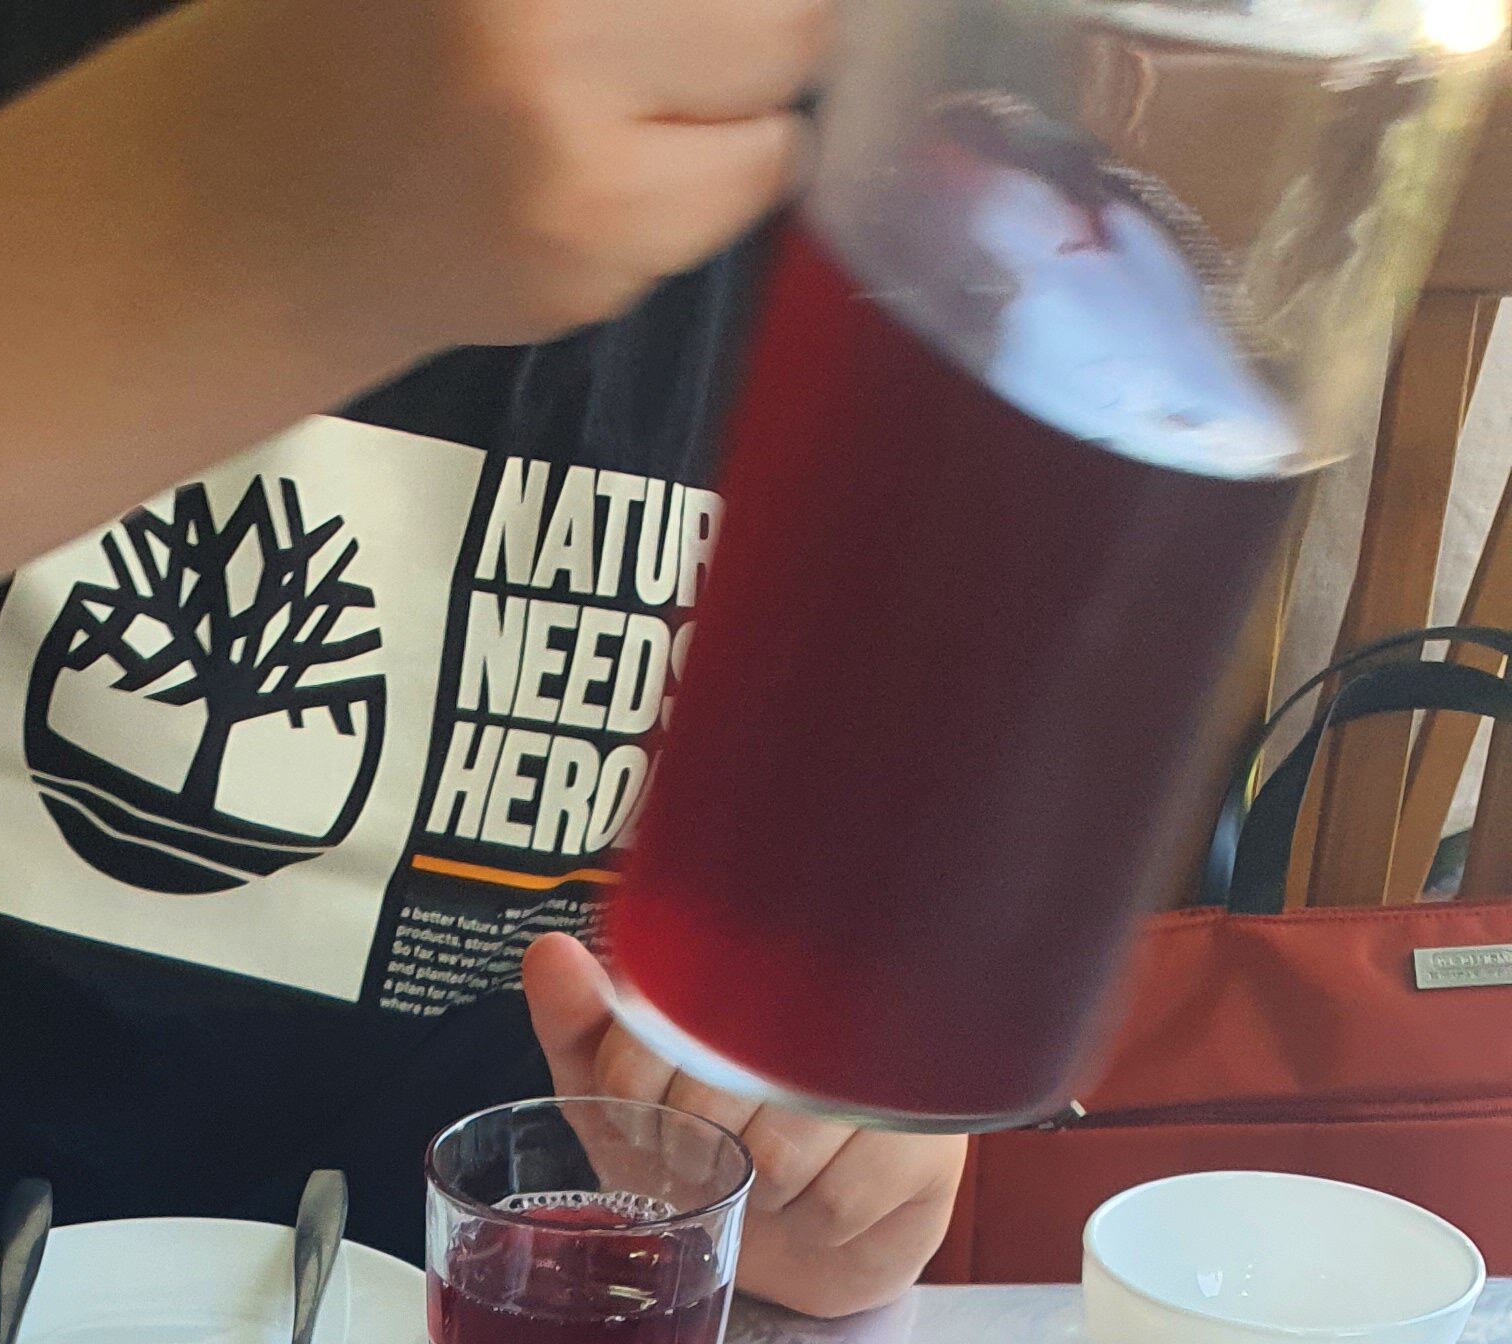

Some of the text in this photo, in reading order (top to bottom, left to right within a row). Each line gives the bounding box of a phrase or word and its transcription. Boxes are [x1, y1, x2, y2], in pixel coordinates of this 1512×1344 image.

[425, 721, 662, 856] HERO
[412, 906, 456, 926] better
[457, 915, 499, 935] future
[392, 940, 412, 957] So
[387, 960, 416, 976] and
[394, 981, 425, 997] plan
